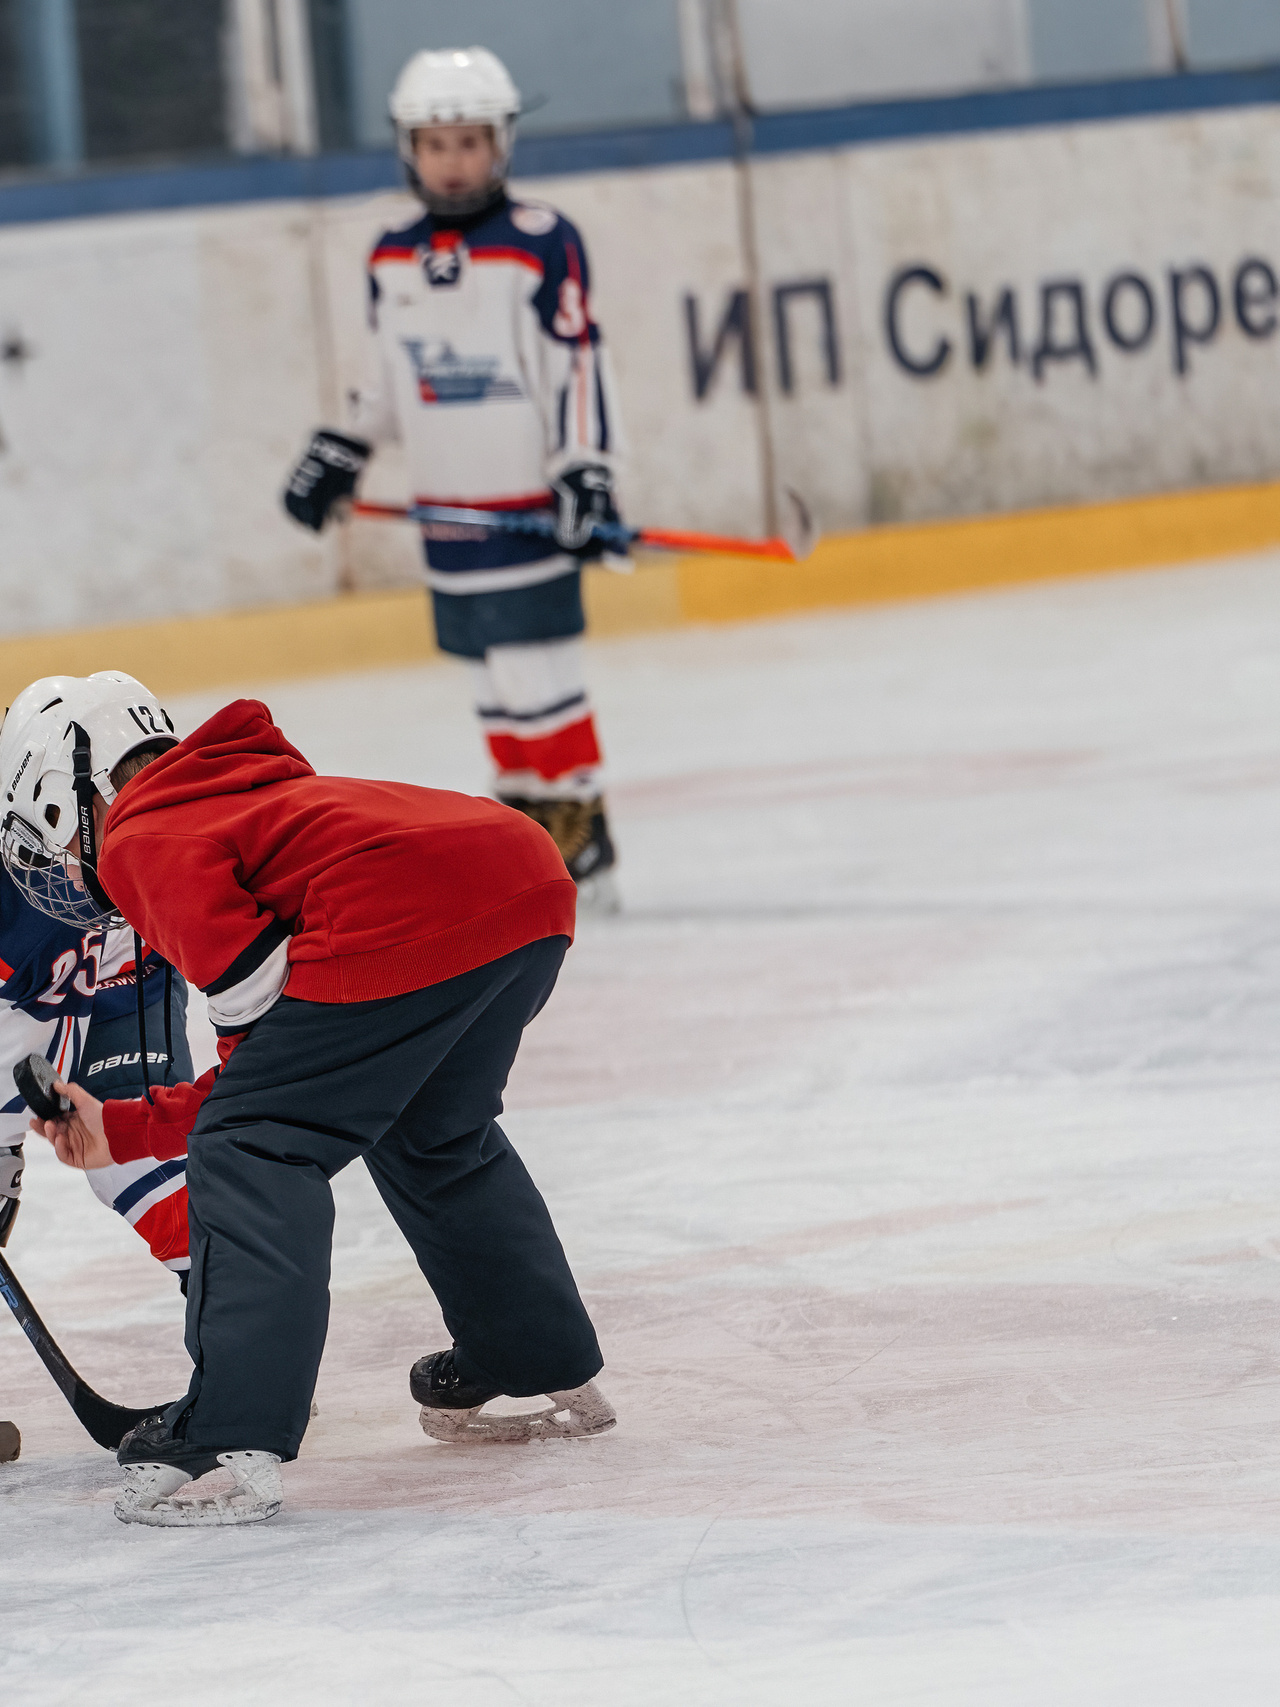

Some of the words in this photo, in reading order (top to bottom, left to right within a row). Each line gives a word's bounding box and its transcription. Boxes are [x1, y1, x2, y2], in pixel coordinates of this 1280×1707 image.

[682, 276, 843, 404] ИП
[884, 259, 1280, 384] Сидоре
[11, 750, 32, 791] BAUER
[80, 805, 91, 855] BAUER
[37, 925, 103, 1005] 25
[86, 1052, 169, 1077] BAUER
